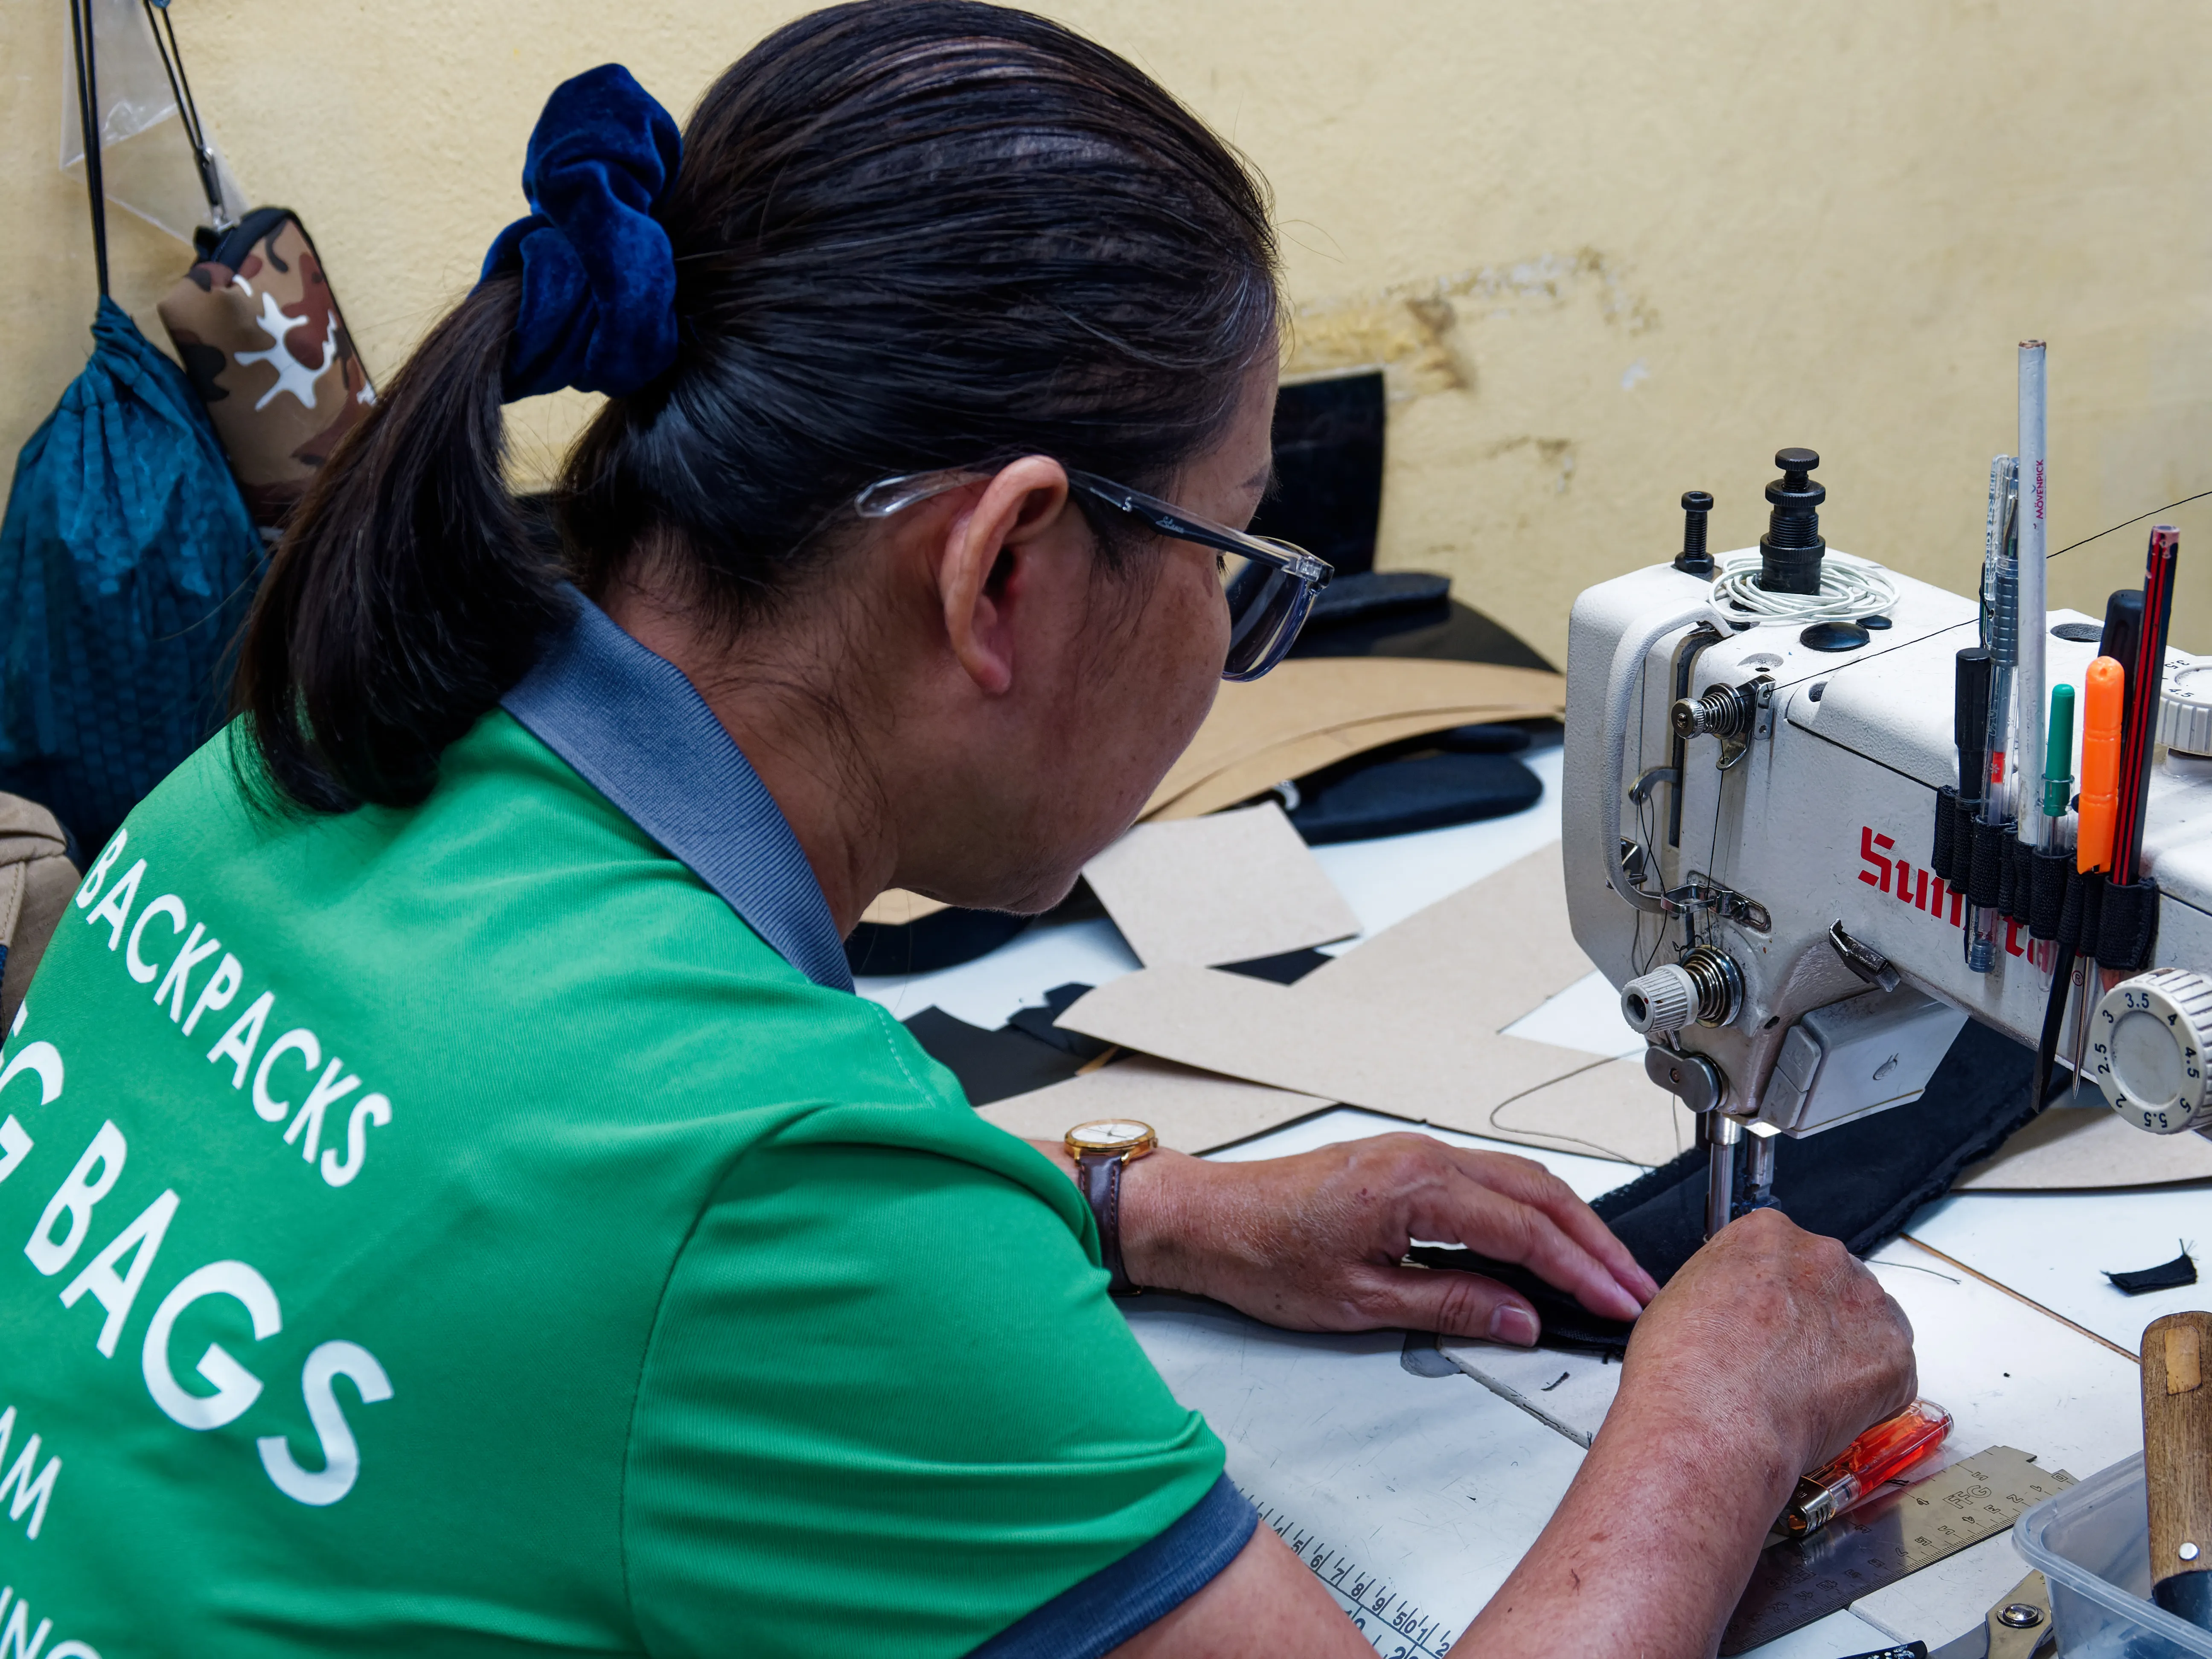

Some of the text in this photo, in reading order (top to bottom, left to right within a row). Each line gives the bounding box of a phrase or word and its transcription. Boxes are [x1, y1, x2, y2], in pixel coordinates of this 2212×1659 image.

[2034, 459, 2044, 519] MÖVENPICK
[2168, 688, 2194, 698] 4.5
[75, 828, 393, 1187] BACKPACKS
[2125, 992, 2150, 1009] 3.5
[2102, 1010, 2114, 1024] 3
[2168, 1013, 2178, 1026] 4
[2095, 1043, 2110, 1074] 2.5
[2185, 1046, 2200, 1079] 4.5
[2115, 1093, 2127, 1108] 2
[2179, 1097, 2192, 1113] 5
[2143, 1112, 2168, 1128] 5.5
[24, 1119, 395, 1507] BAGS
[2006, 1494, 2024, 1504] 2
[1983, 1504, 2001, 1514] 3
[1895, 1547, 1909, 1557] 7
[1310, 1554, 1323, 1568] 6
[1330, 1567, 1345, 1581] 7
[1351, 1583, 1365, 1597] 8
[1371, 1597, 1385, 1611] 9
[1435, 1642, 1450, 1657] 2
